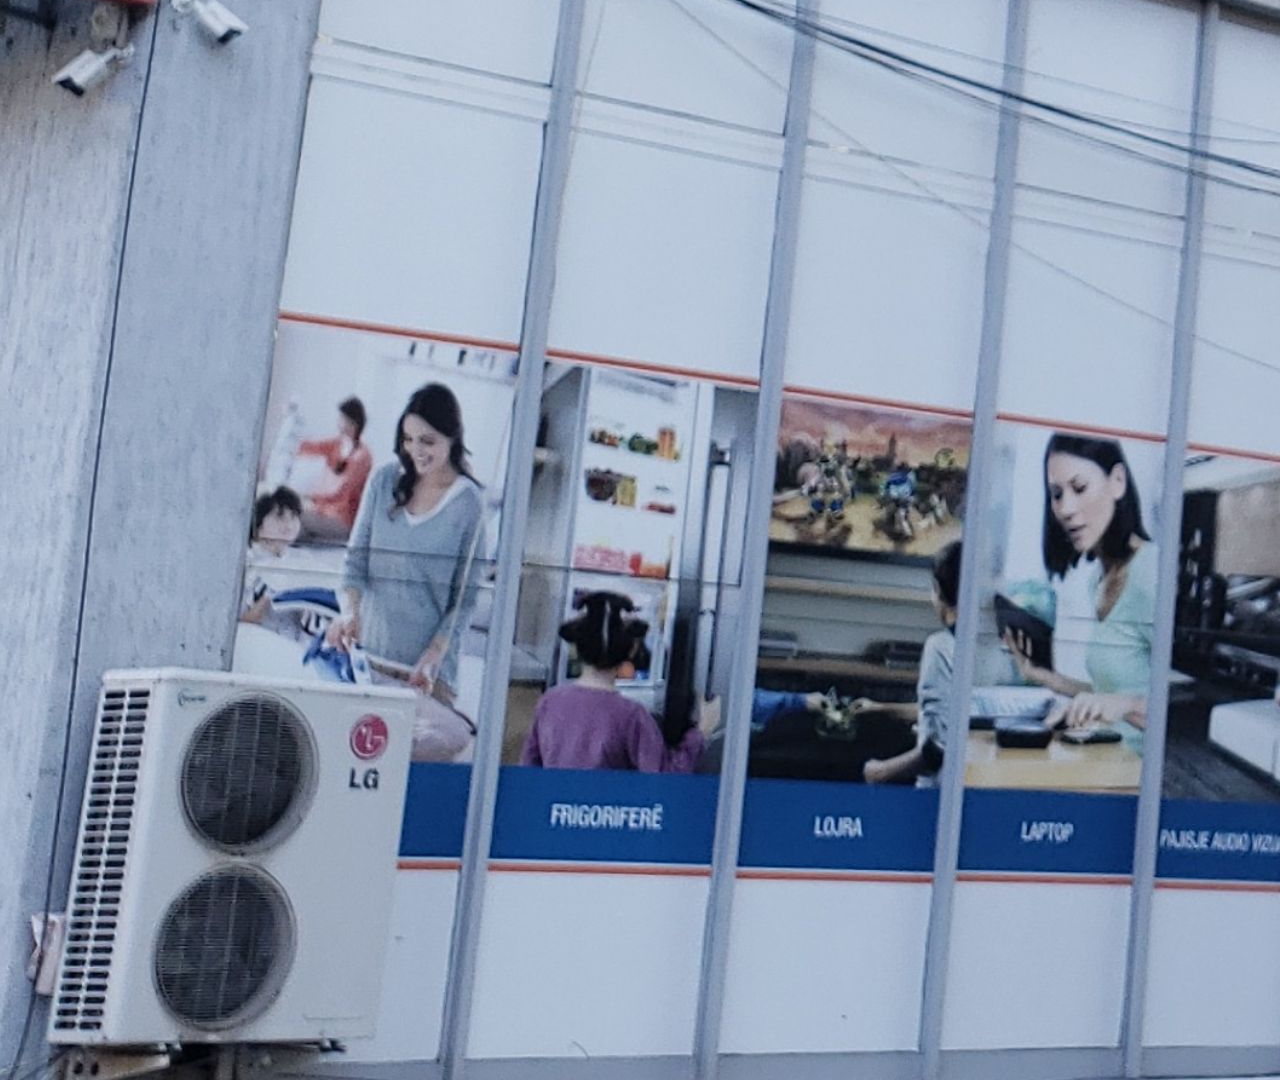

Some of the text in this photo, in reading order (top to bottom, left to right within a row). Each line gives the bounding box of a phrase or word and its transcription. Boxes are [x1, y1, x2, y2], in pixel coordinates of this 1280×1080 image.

[349, 768, 380, 790] LG
[813, 816, 863, 838] LOJRA
[1020, 821, 1074, 843] LAPTOP
[1210, 831, 1249, 852] AUDIO
